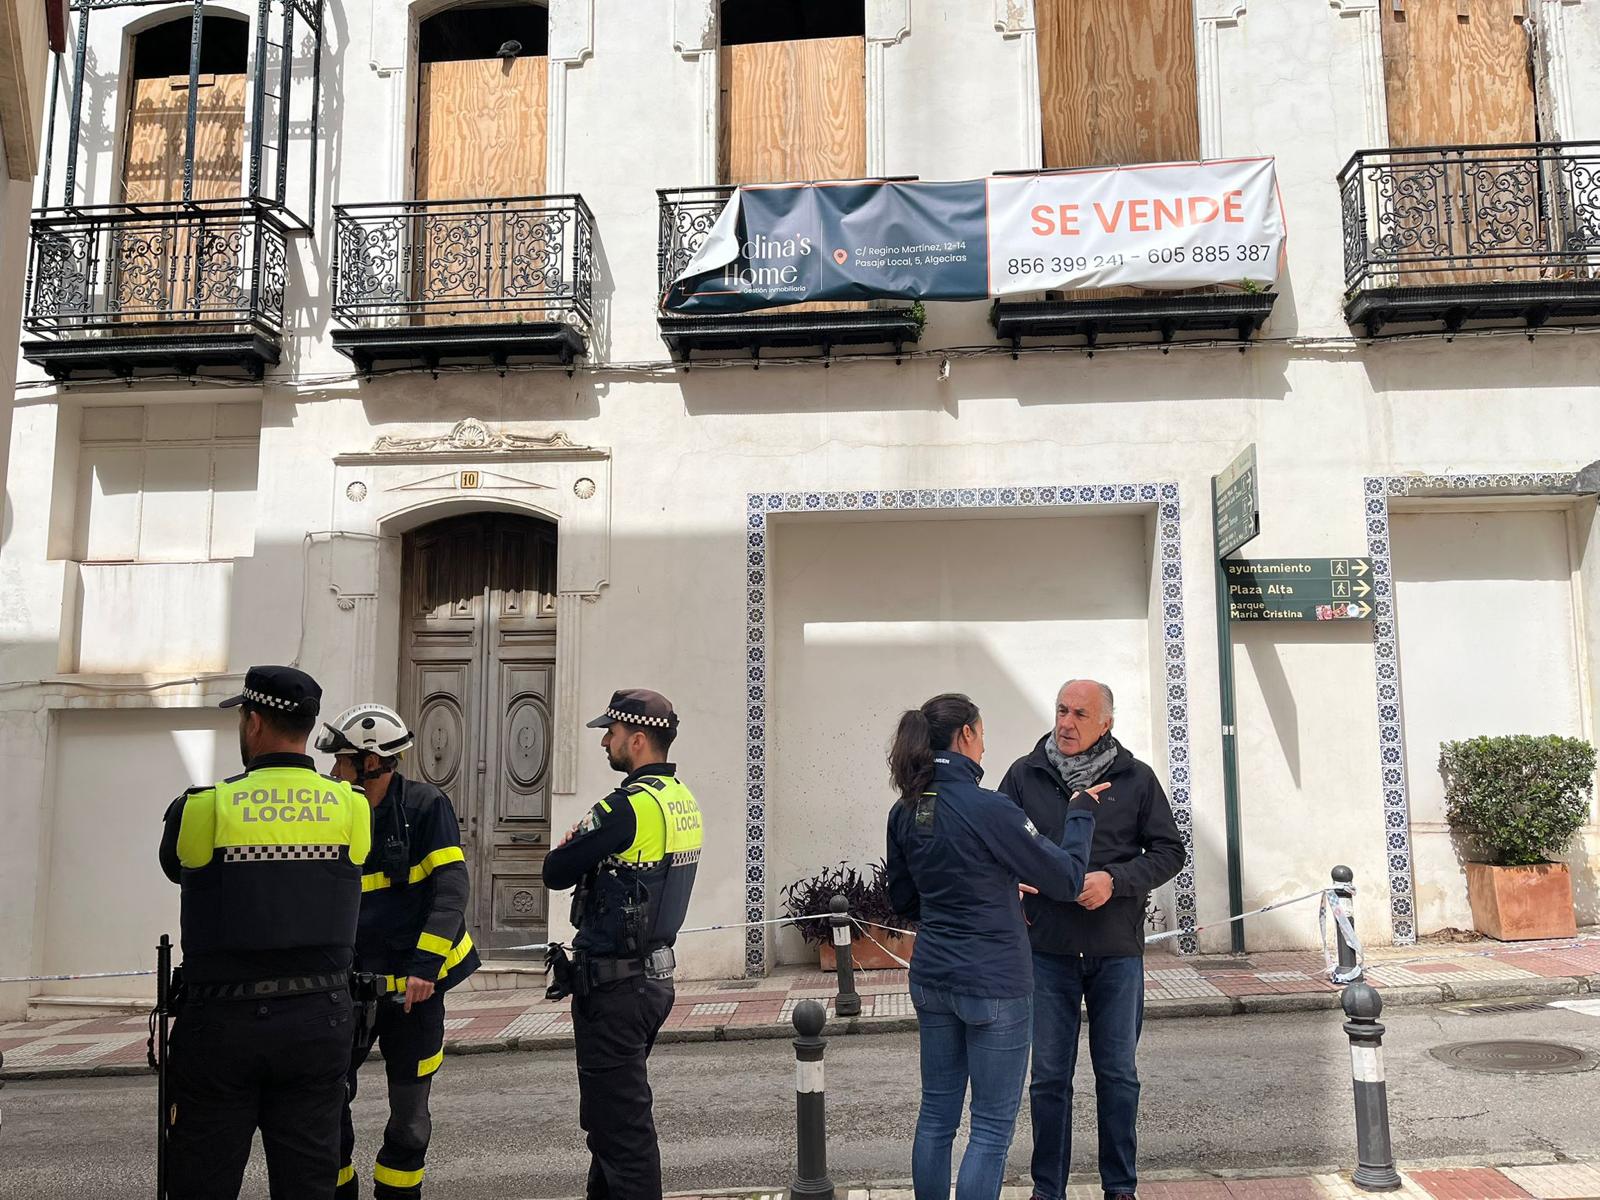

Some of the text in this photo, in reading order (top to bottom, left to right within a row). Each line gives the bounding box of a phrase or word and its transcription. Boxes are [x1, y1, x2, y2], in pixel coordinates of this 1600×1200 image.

[1030, 190, 1245, 236] SE VENDE
[742, 233, 812, 260] dina's
[855, 246, 866, 257] C/
[869, 246, 899, 257] Regino
[944, 241, 967, 251] 12-14
[855, 253, 967, 269] Pasaje Local, 5, Algeciras
[1008, 257, 1045, 275] 856
[1051, 256, 1087, 273] 399
[1094, 254, 1124, 268] 241
[1148, 246, 1186, 264] 605
[1192, 245, 1230, 263] 885
[1236, 245, 1271, 262] 387
[724, 264, 798, 287] Home
[464, 474, 474, 486] 10
[1229, 563, 1312, 575] ayuntamiento
[1229, 584, 1294, 594] Plaza Alta
[1230, 602, 1265, 610] parque
[1263, 610, 1303, 618] Cristina
[232, 788, 339, 805] POLICIA
[243, 805, 330, 822] LOCAL
[667, 800, 700, 815] POLICIA
[676, 815, 700, 831] LOCAL
